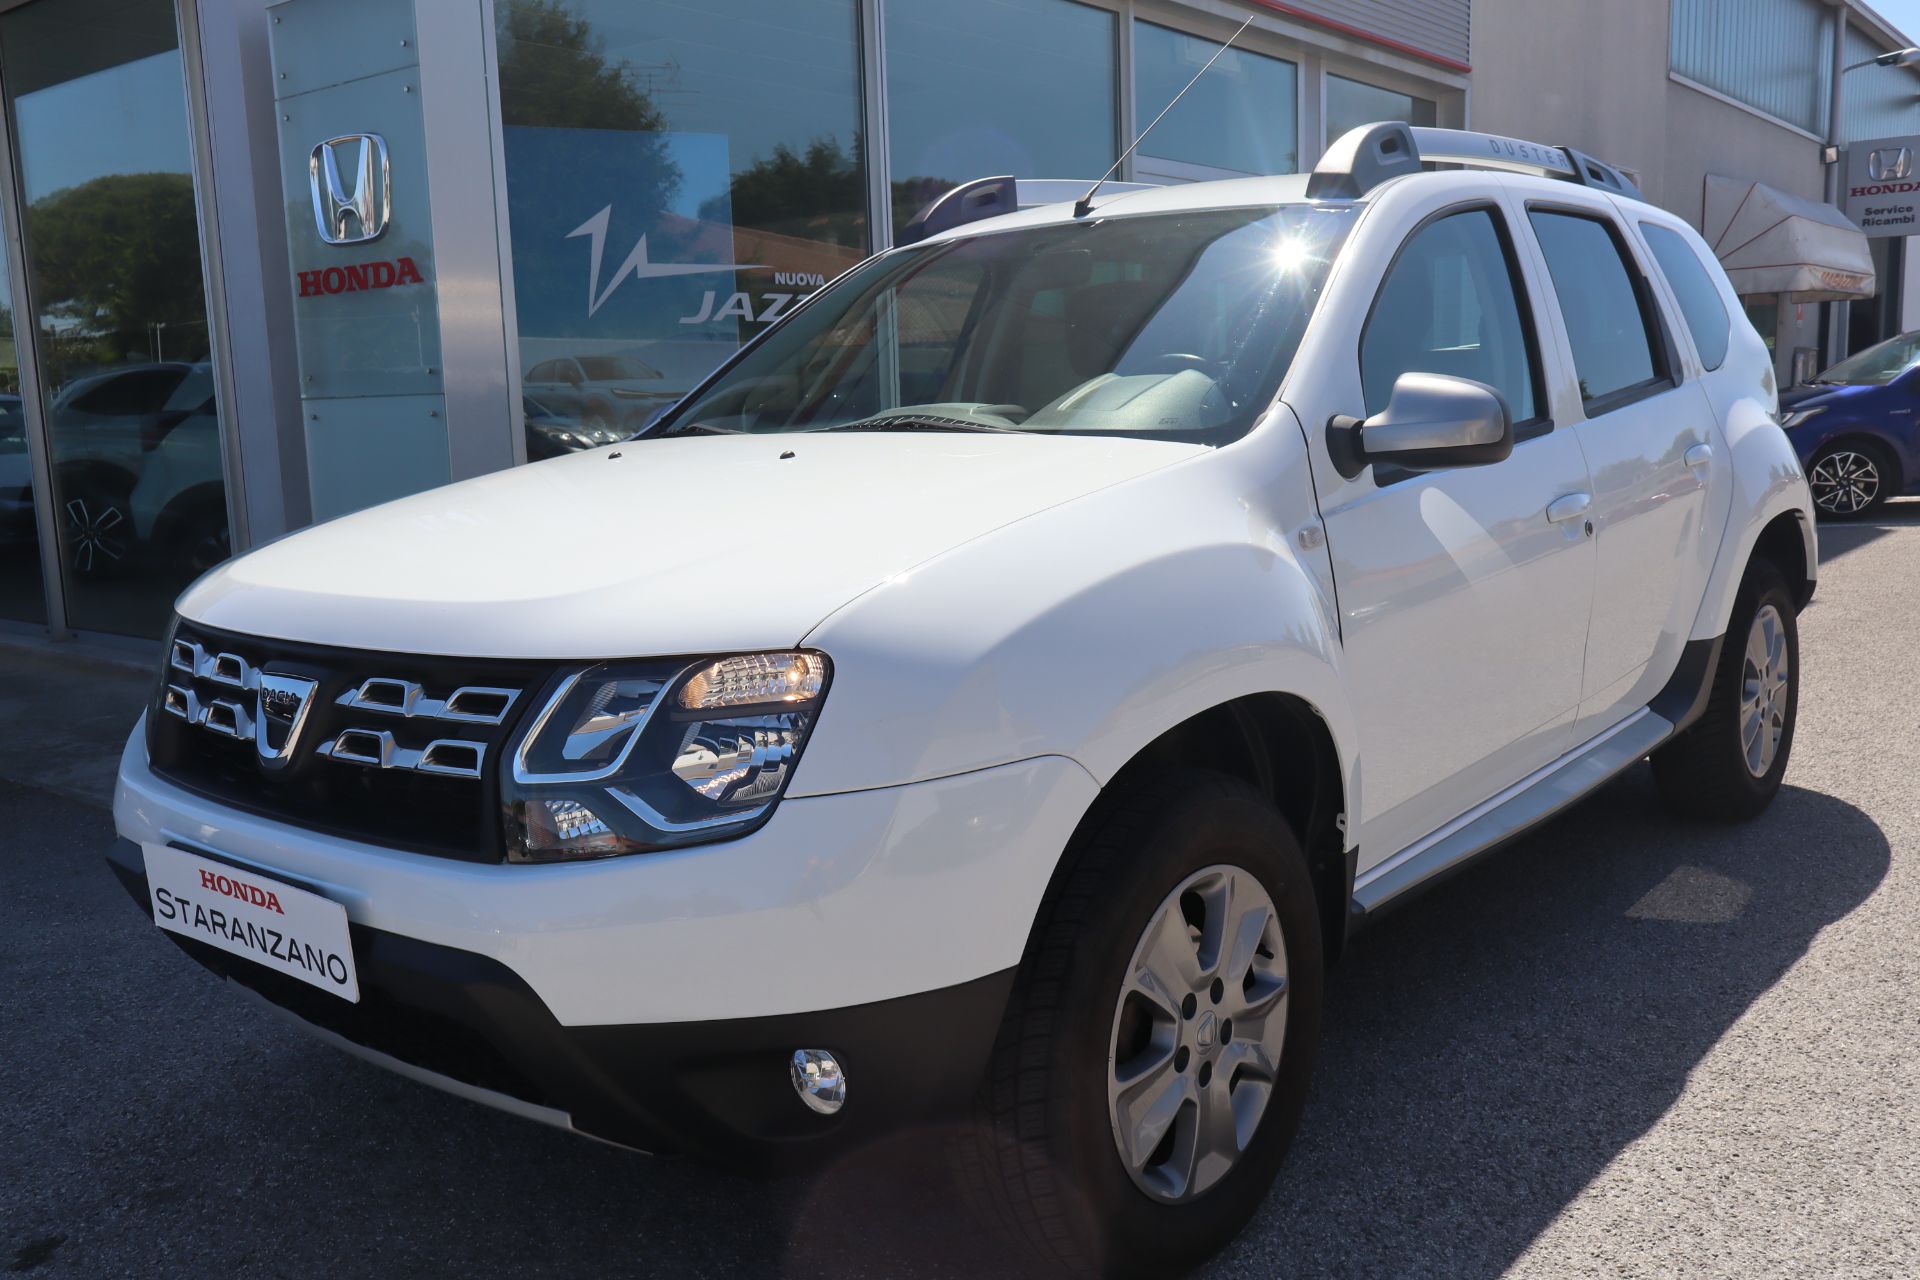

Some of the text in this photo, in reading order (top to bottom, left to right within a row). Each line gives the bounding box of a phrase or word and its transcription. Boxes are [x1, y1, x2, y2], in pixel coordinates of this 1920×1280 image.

[1488, 139, 1568, 168] DUSTER
[1861, 215, 1915, 227] Ricambi
[1864, 205, 1914, 216] Service
[297, 256, 425, 298] HONDA
[774, 271, 826, 286] NUOVA
[679, 290, 812, 324] JAZ
[262, 687, 299, 705] DACIA
[199, 868, 285, 915] HONDA
[155, 887, 348, 985] STARANZANO
